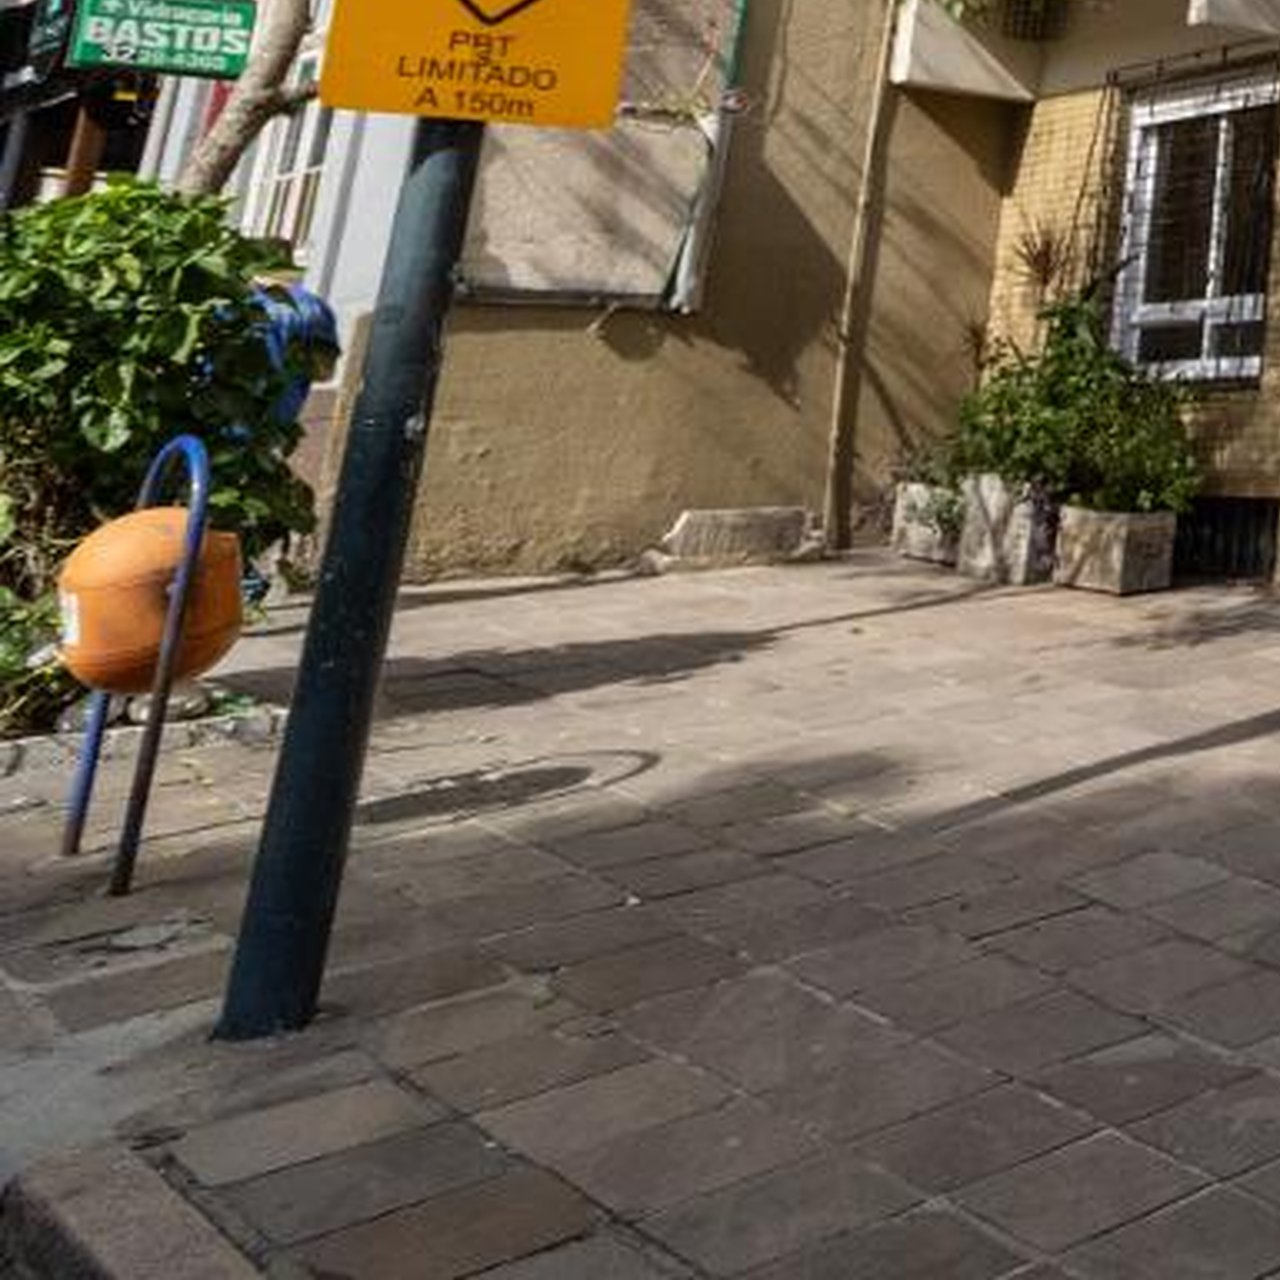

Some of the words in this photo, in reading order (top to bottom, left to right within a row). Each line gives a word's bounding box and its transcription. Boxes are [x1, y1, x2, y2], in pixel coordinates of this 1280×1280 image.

[84, 16, 250, 54] BASTOS
[448, 30, 516, 58] PBT
[398, 55, 557, 92] LIMITADO
[414, 86, 438, 108] A
[454, 90, 535, 118] 150m
